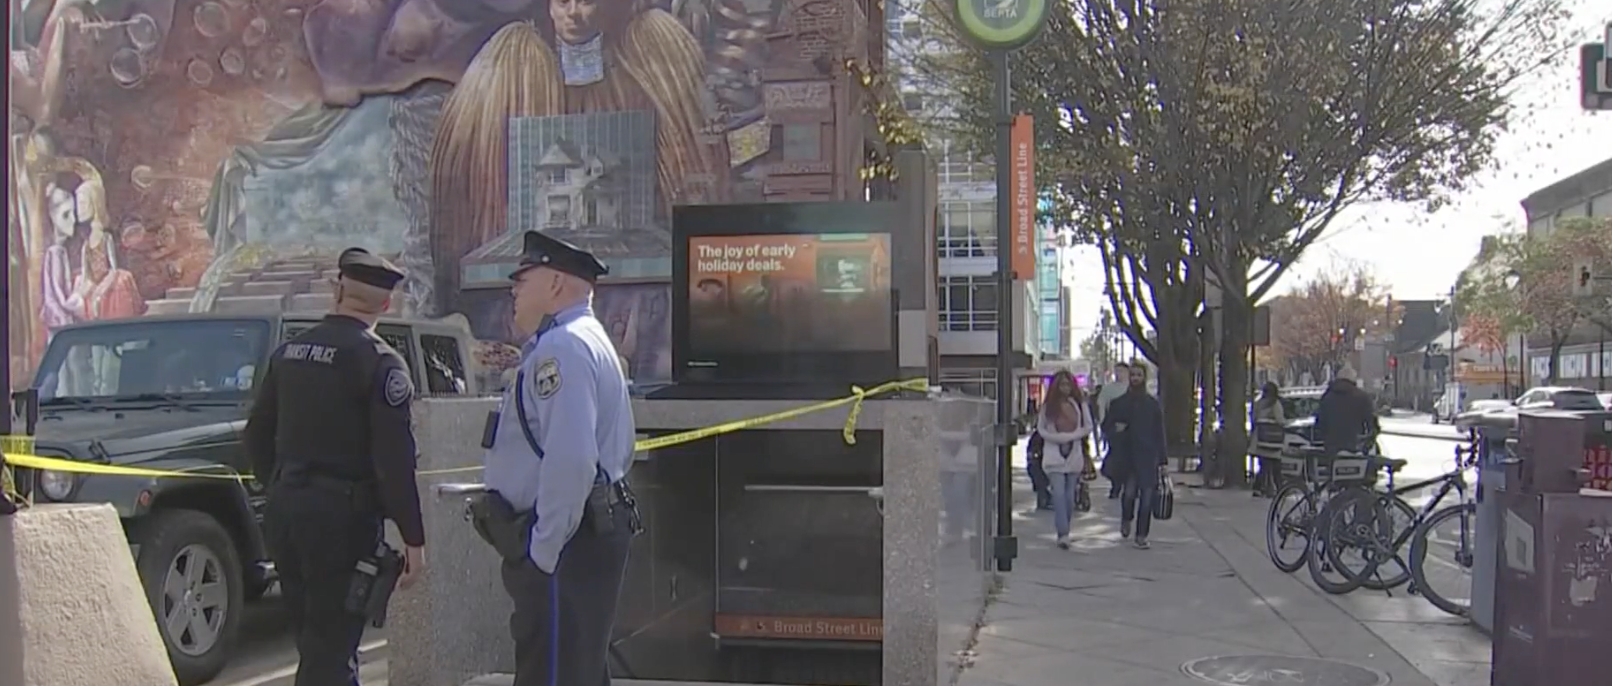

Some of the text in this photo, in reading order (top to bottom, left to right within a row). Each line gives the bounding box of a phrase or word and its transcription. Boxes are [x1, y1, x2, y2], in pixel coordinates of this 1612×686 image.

[984, 8, 1017, 18] SEPTA
[1017, 143, 1028, 244] Broad Street Line
[698, 244, 796, 259] The joy of early
[698, 259, 786, 273] holiday deals.
[308, 345, 337, 364] POLICE
[774, 621, 812, 634] Broad
[816, 622, 856, 635] Street
